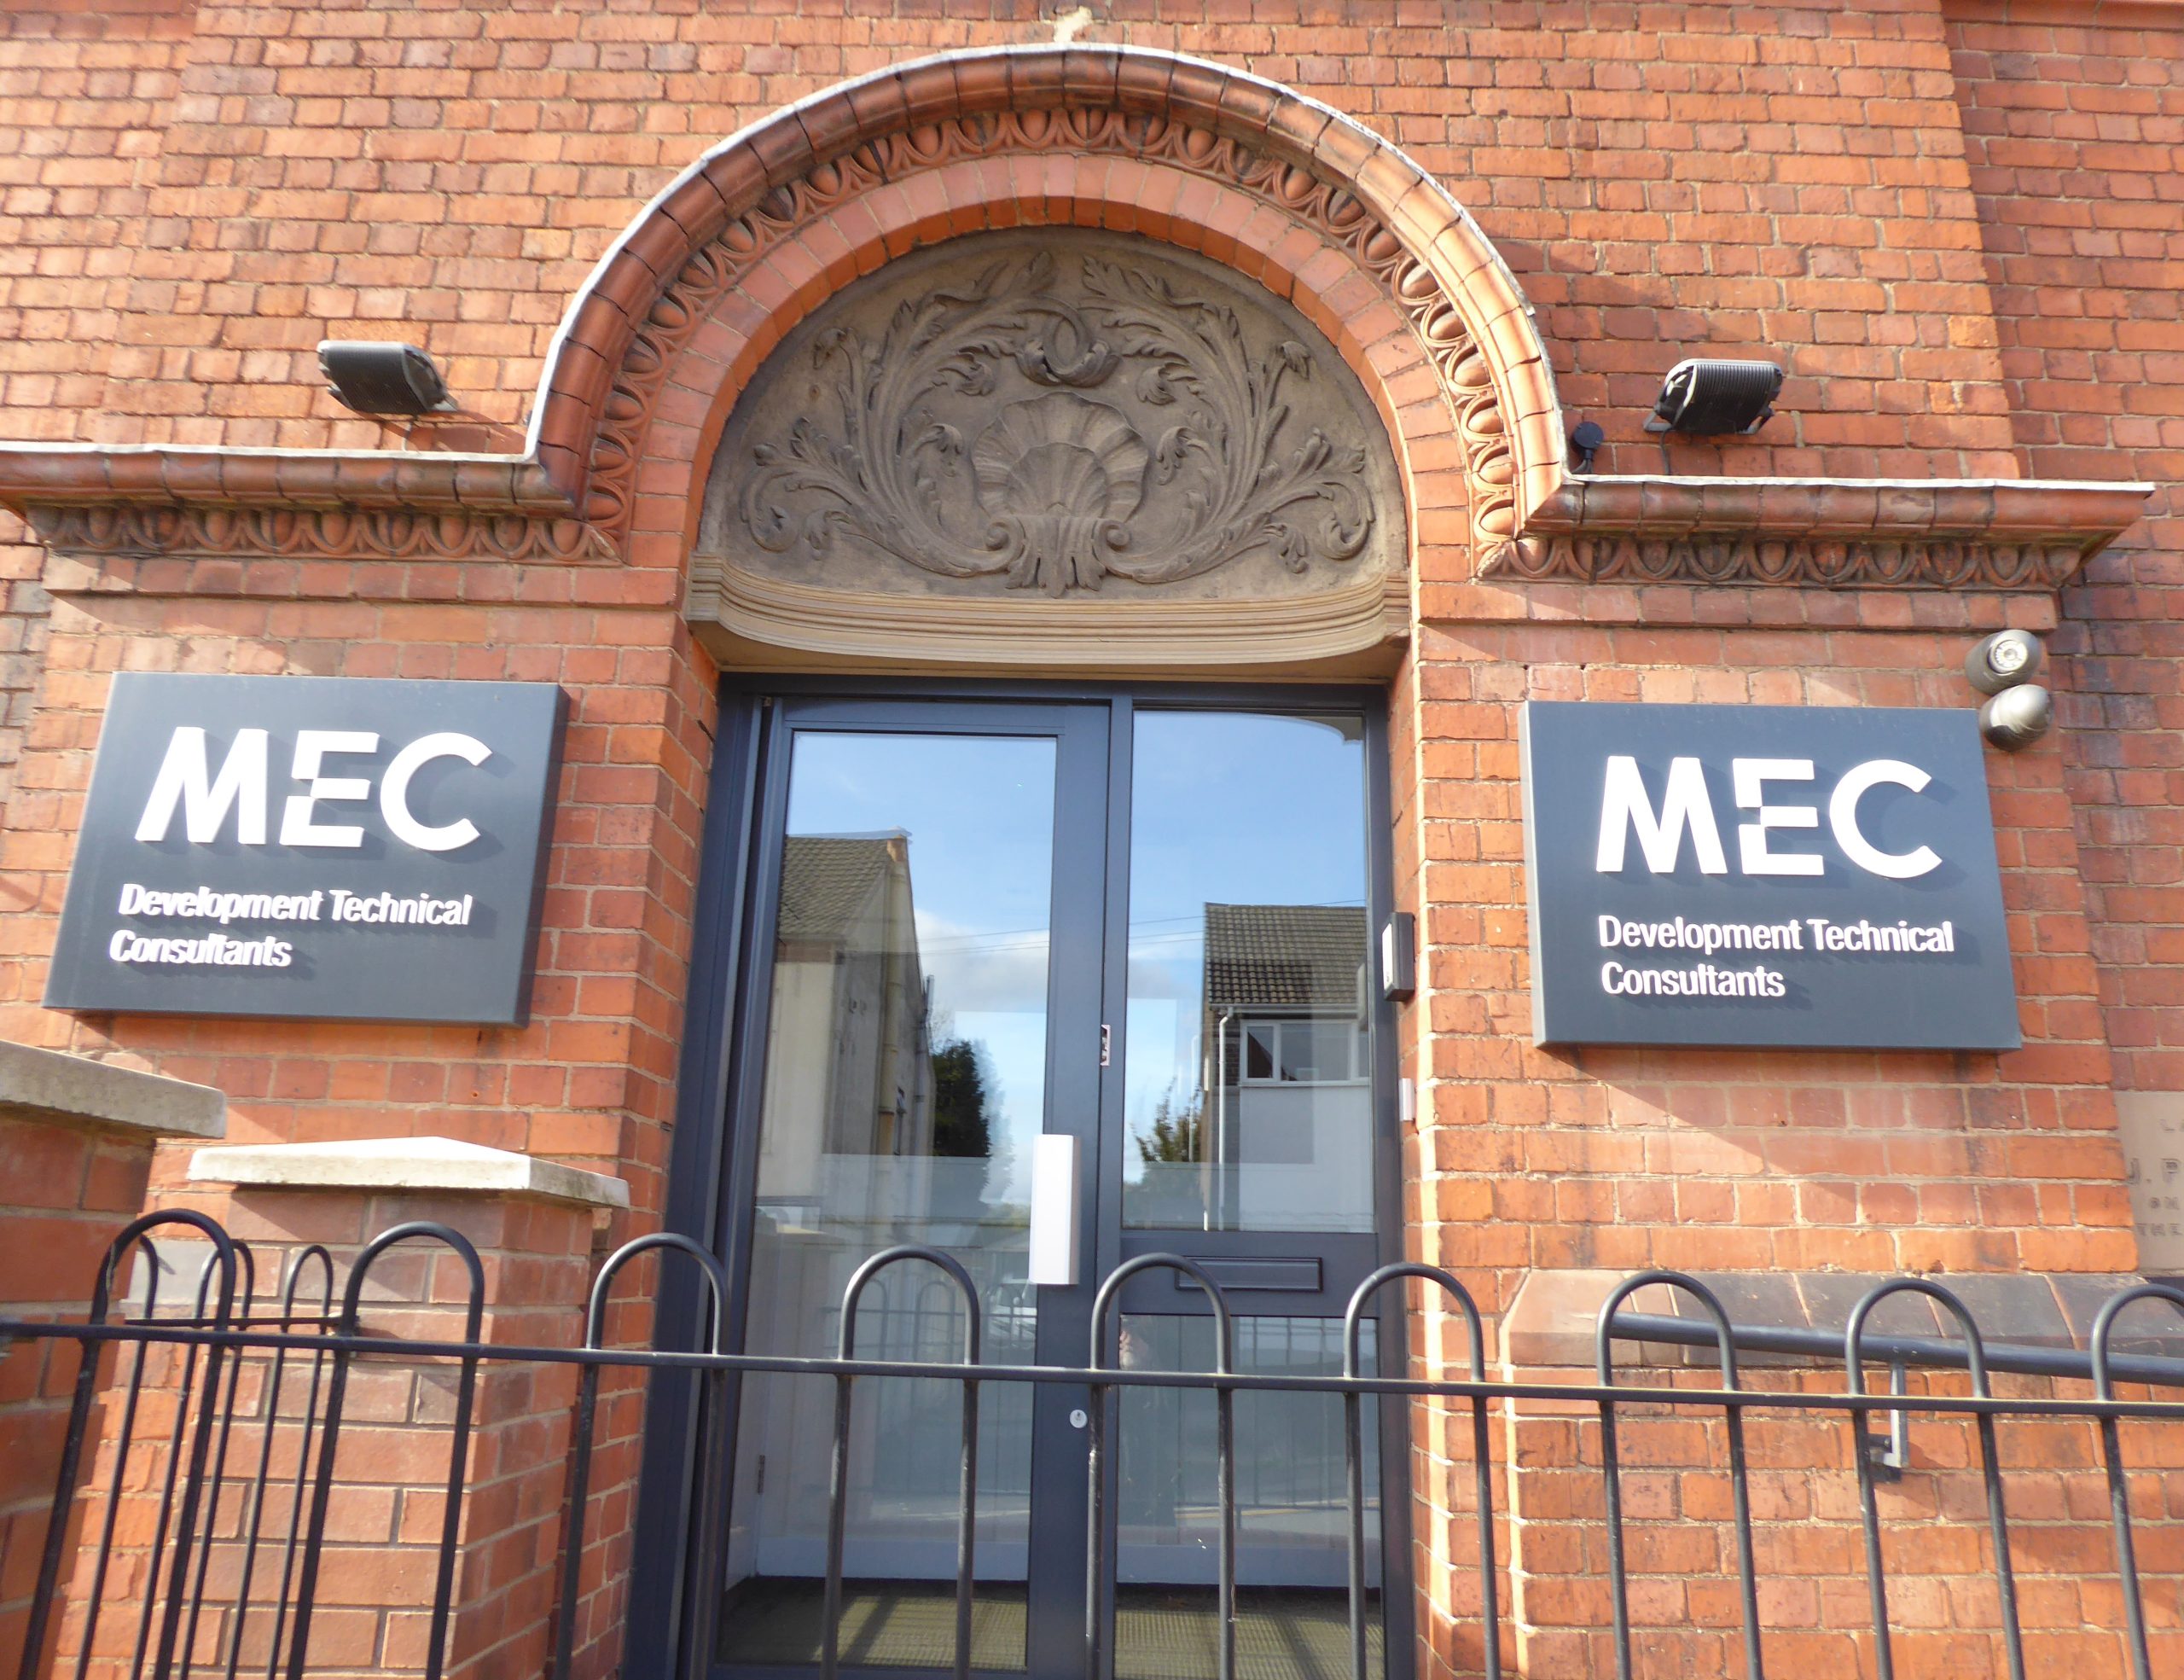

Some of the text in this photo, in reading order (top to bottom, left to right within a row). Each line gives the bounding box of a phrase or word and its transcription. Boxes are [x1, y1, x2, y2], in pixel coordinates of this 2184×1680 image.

[135, 726, 493, 852] MEC
[1595, 755, 1943, 879] MEC
[118, 882, 474, 926] Development Technical
[108, 929, 293, 968] Consultants
[1597, 915, 1955, 955] Development Technical
[1600, 962, 1786, 997] Consultants
